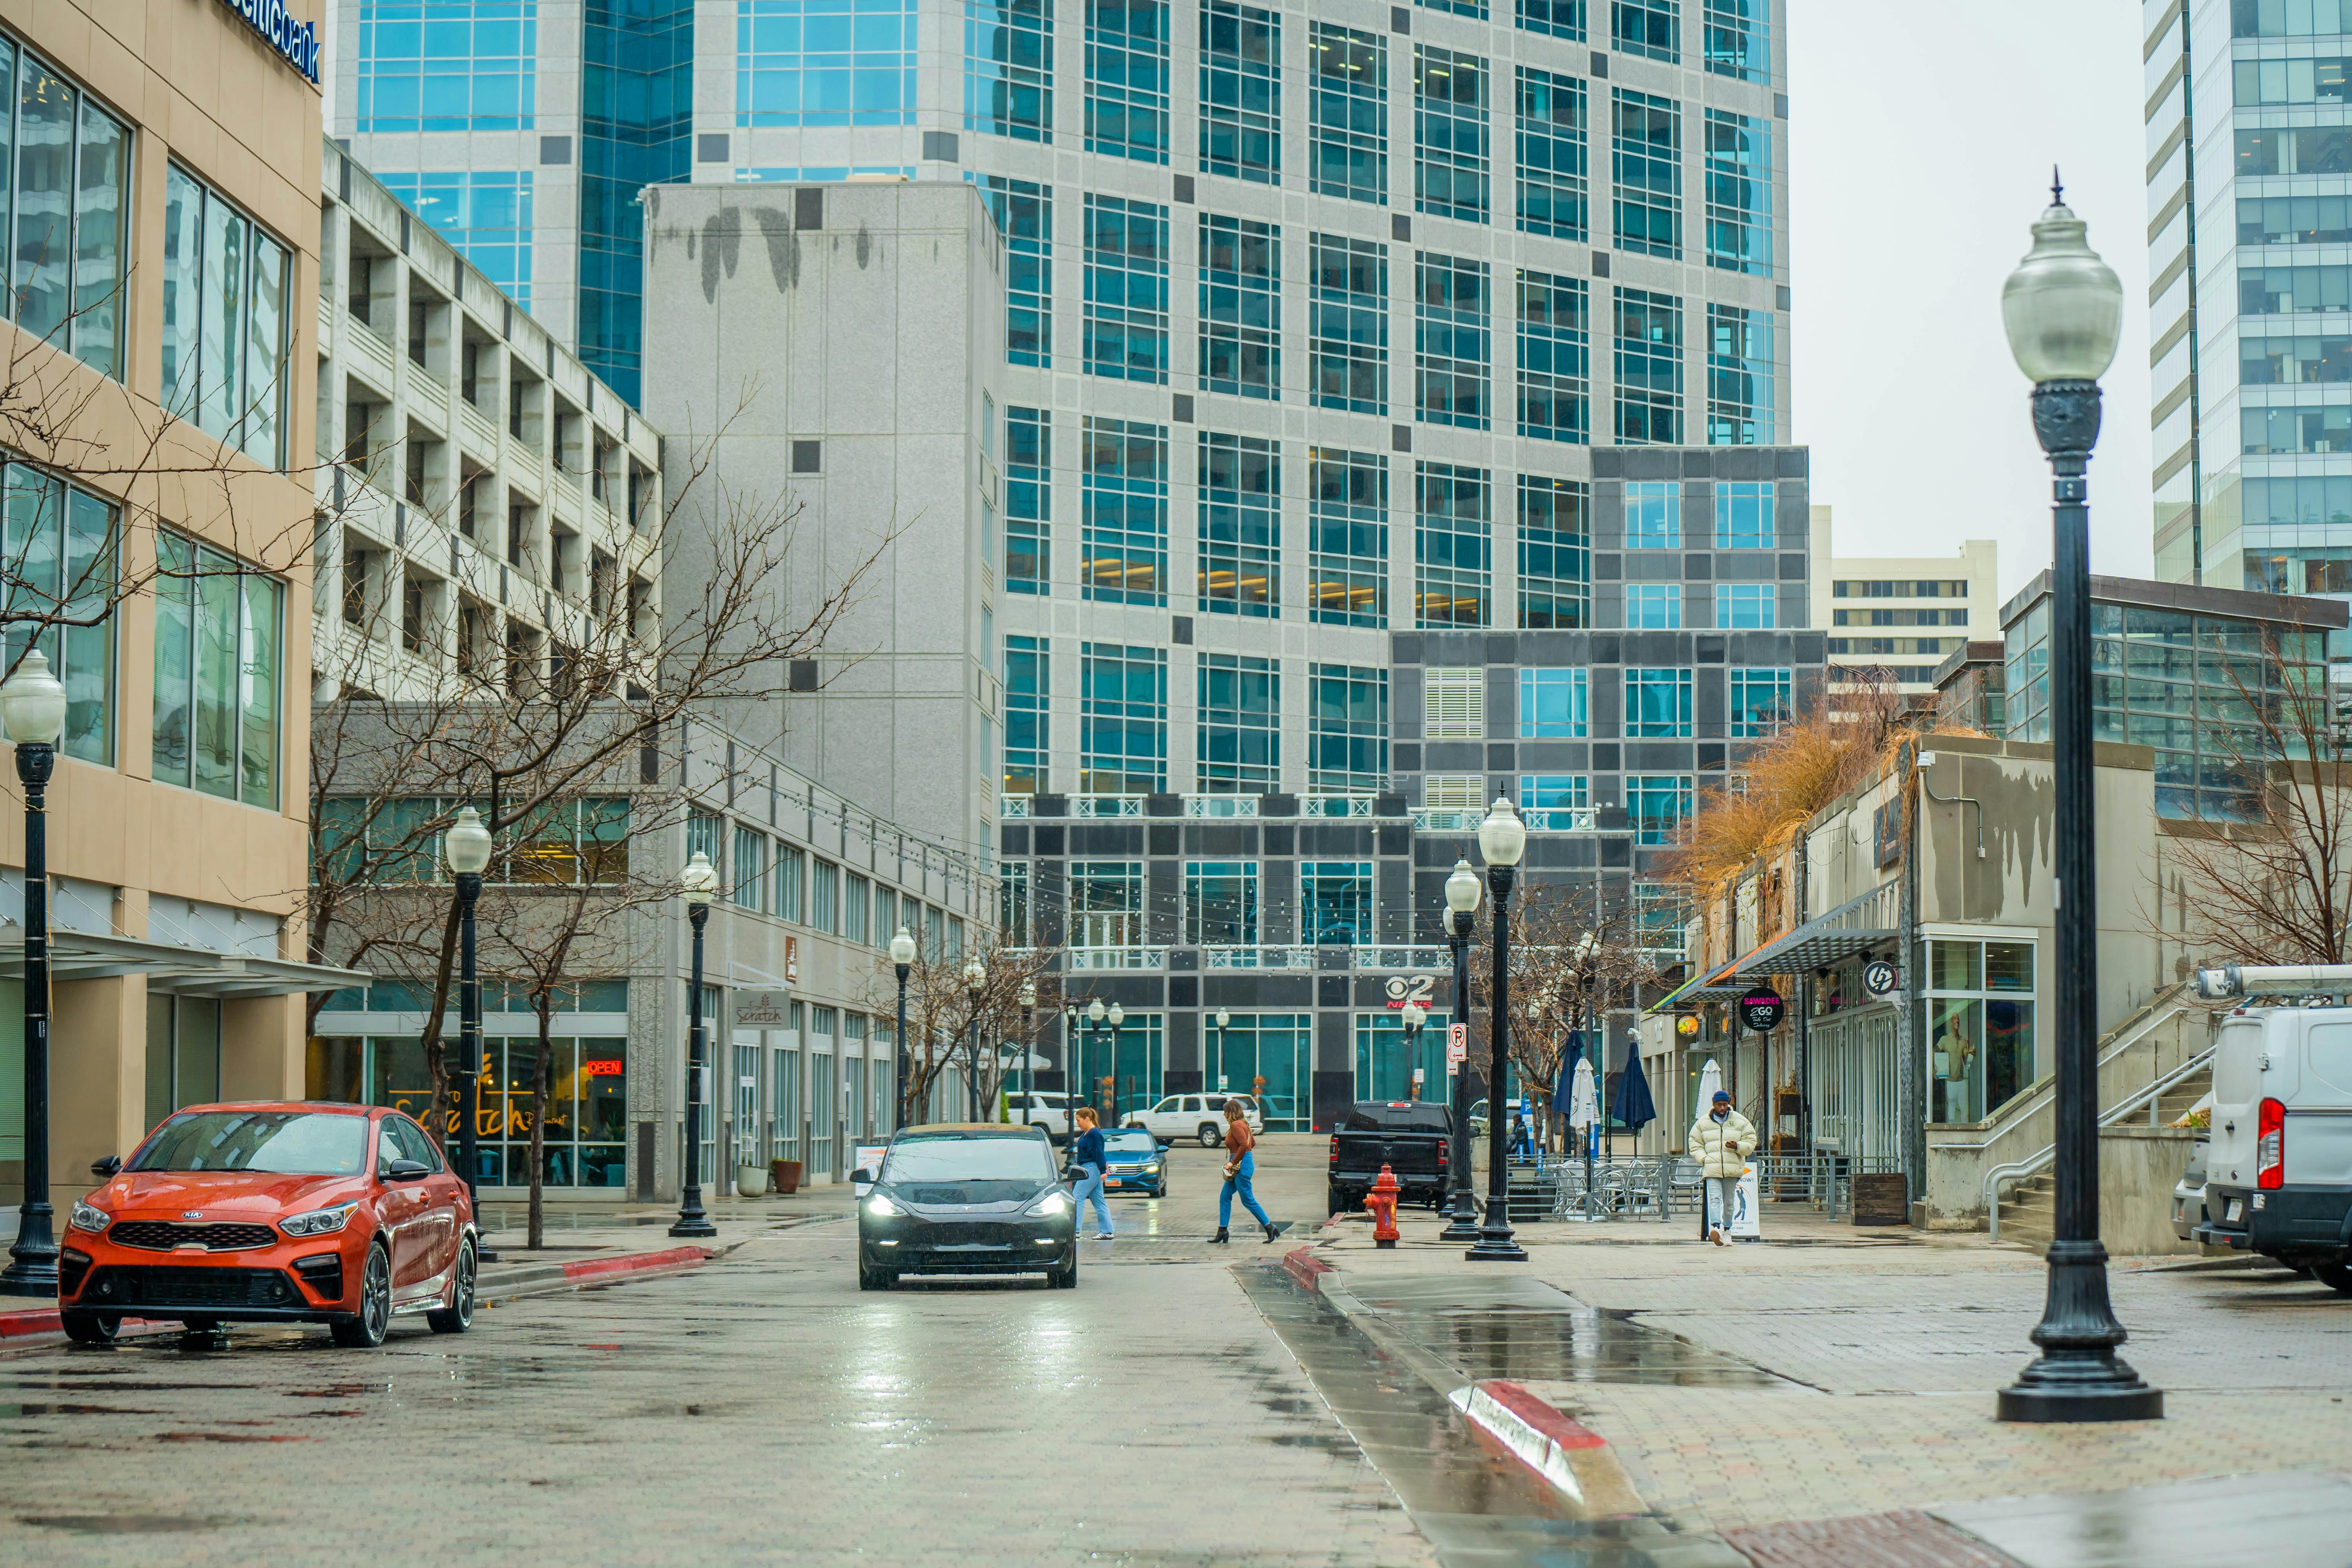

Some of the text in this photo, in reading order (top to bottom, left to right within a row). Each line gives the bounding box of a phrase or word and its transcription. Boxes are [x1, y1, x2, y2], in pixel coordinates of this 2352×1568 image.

[227, 0, 321, 84] ticbank
[1406, 975, 1434, 1000] 2
[737, 1009, 782, 1022] Scratch
[1750, 1006, 1773, 1016] 2GO
[590, 1063, 619, 1073] OPEN
